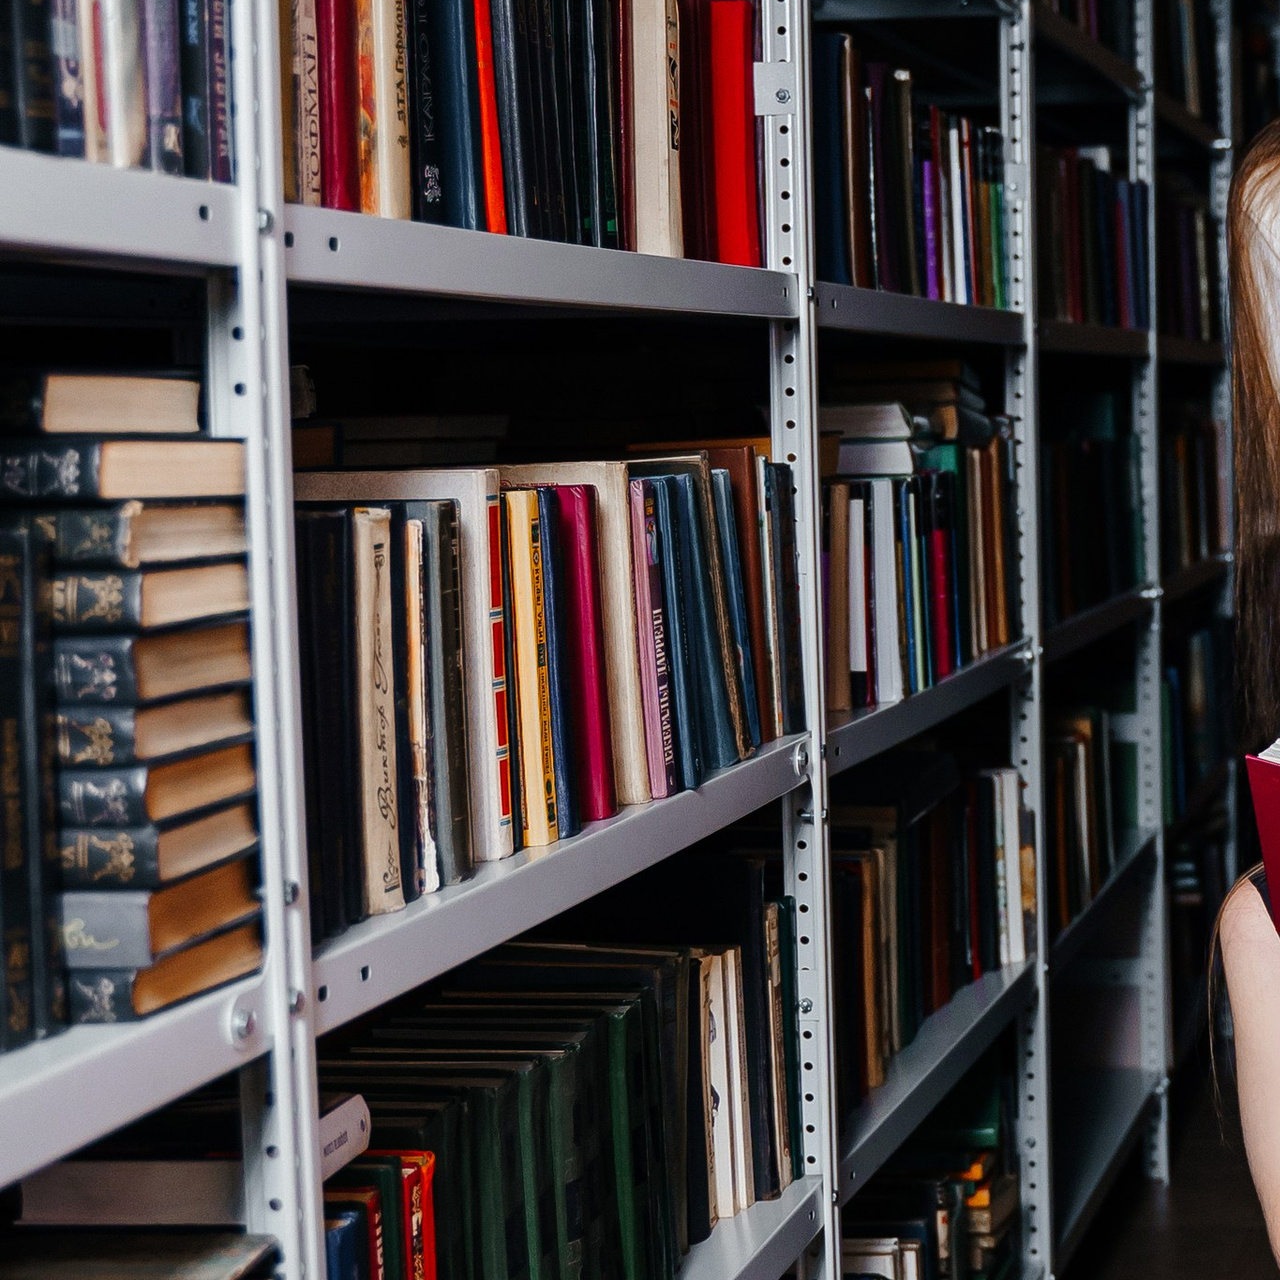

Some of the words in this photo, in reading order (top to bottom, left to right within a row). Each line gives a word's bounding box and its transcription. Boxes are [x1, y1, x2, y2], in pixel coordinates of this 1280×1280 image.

[305, 32, 321, 195] ГОФМАН
[420, 30, 435, 143] КАРЛО
[652, 608, 669, 677] ДАРРЕЛЛ
[376, 705, 397, 830] Виктор
